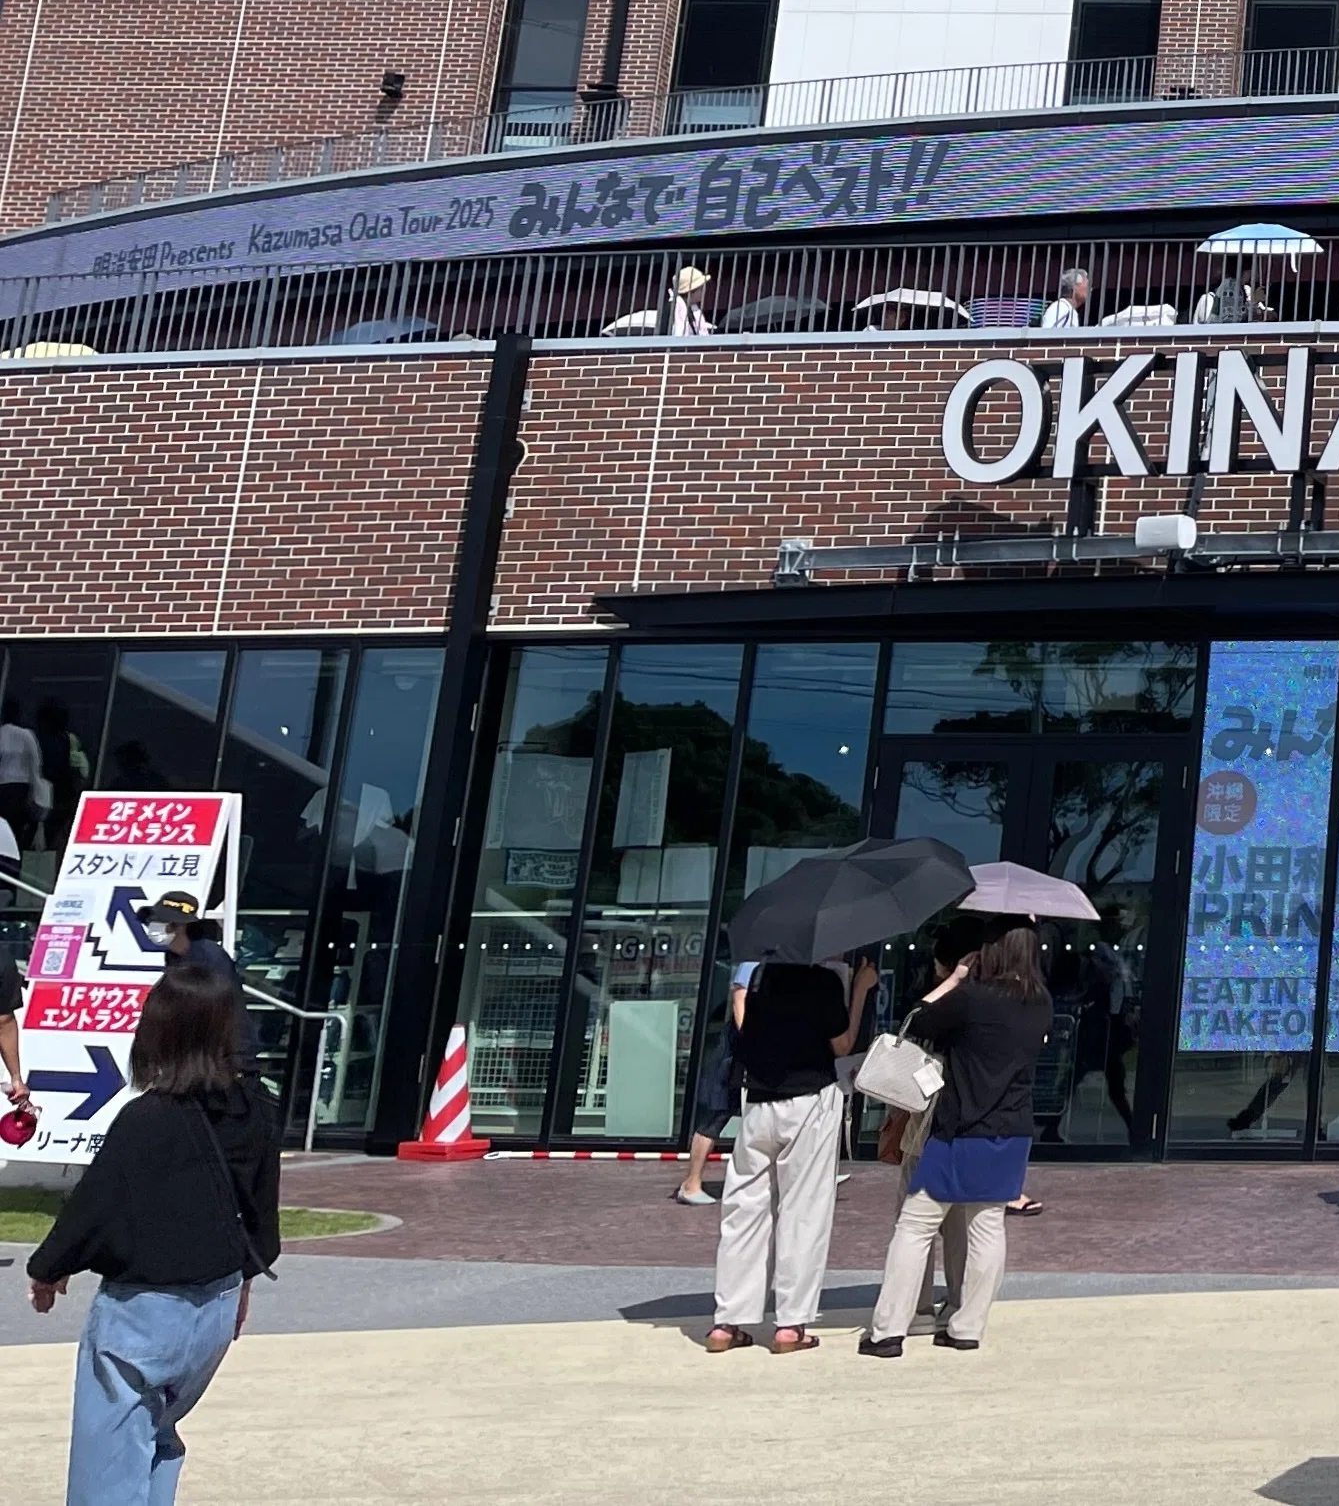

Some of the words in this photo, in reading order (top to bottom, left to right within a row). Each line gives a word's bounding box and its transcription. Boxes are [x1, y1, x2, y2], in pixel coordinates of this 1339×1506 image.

[159, 240, 236, 269] Presents
[247, 222, 343, 256] Kazumasa
[348, 211, 393, 242] Oda
[399, 205, 444, 235] Tour
[445, 196, 499, 232] 2025
[106, 800, 137, 822] 2F
[137, 801, 192, 823] メイン
[90, 822, 197, 844] エントランス
[68, 853, 135, 876] スタンド
[157, 854, 201, 877] 立見
[60, 985, 88, 1007] 1F
[88, 987, 141, 1009] サウス
[17, 1131, 106, 1153] リーナ席
